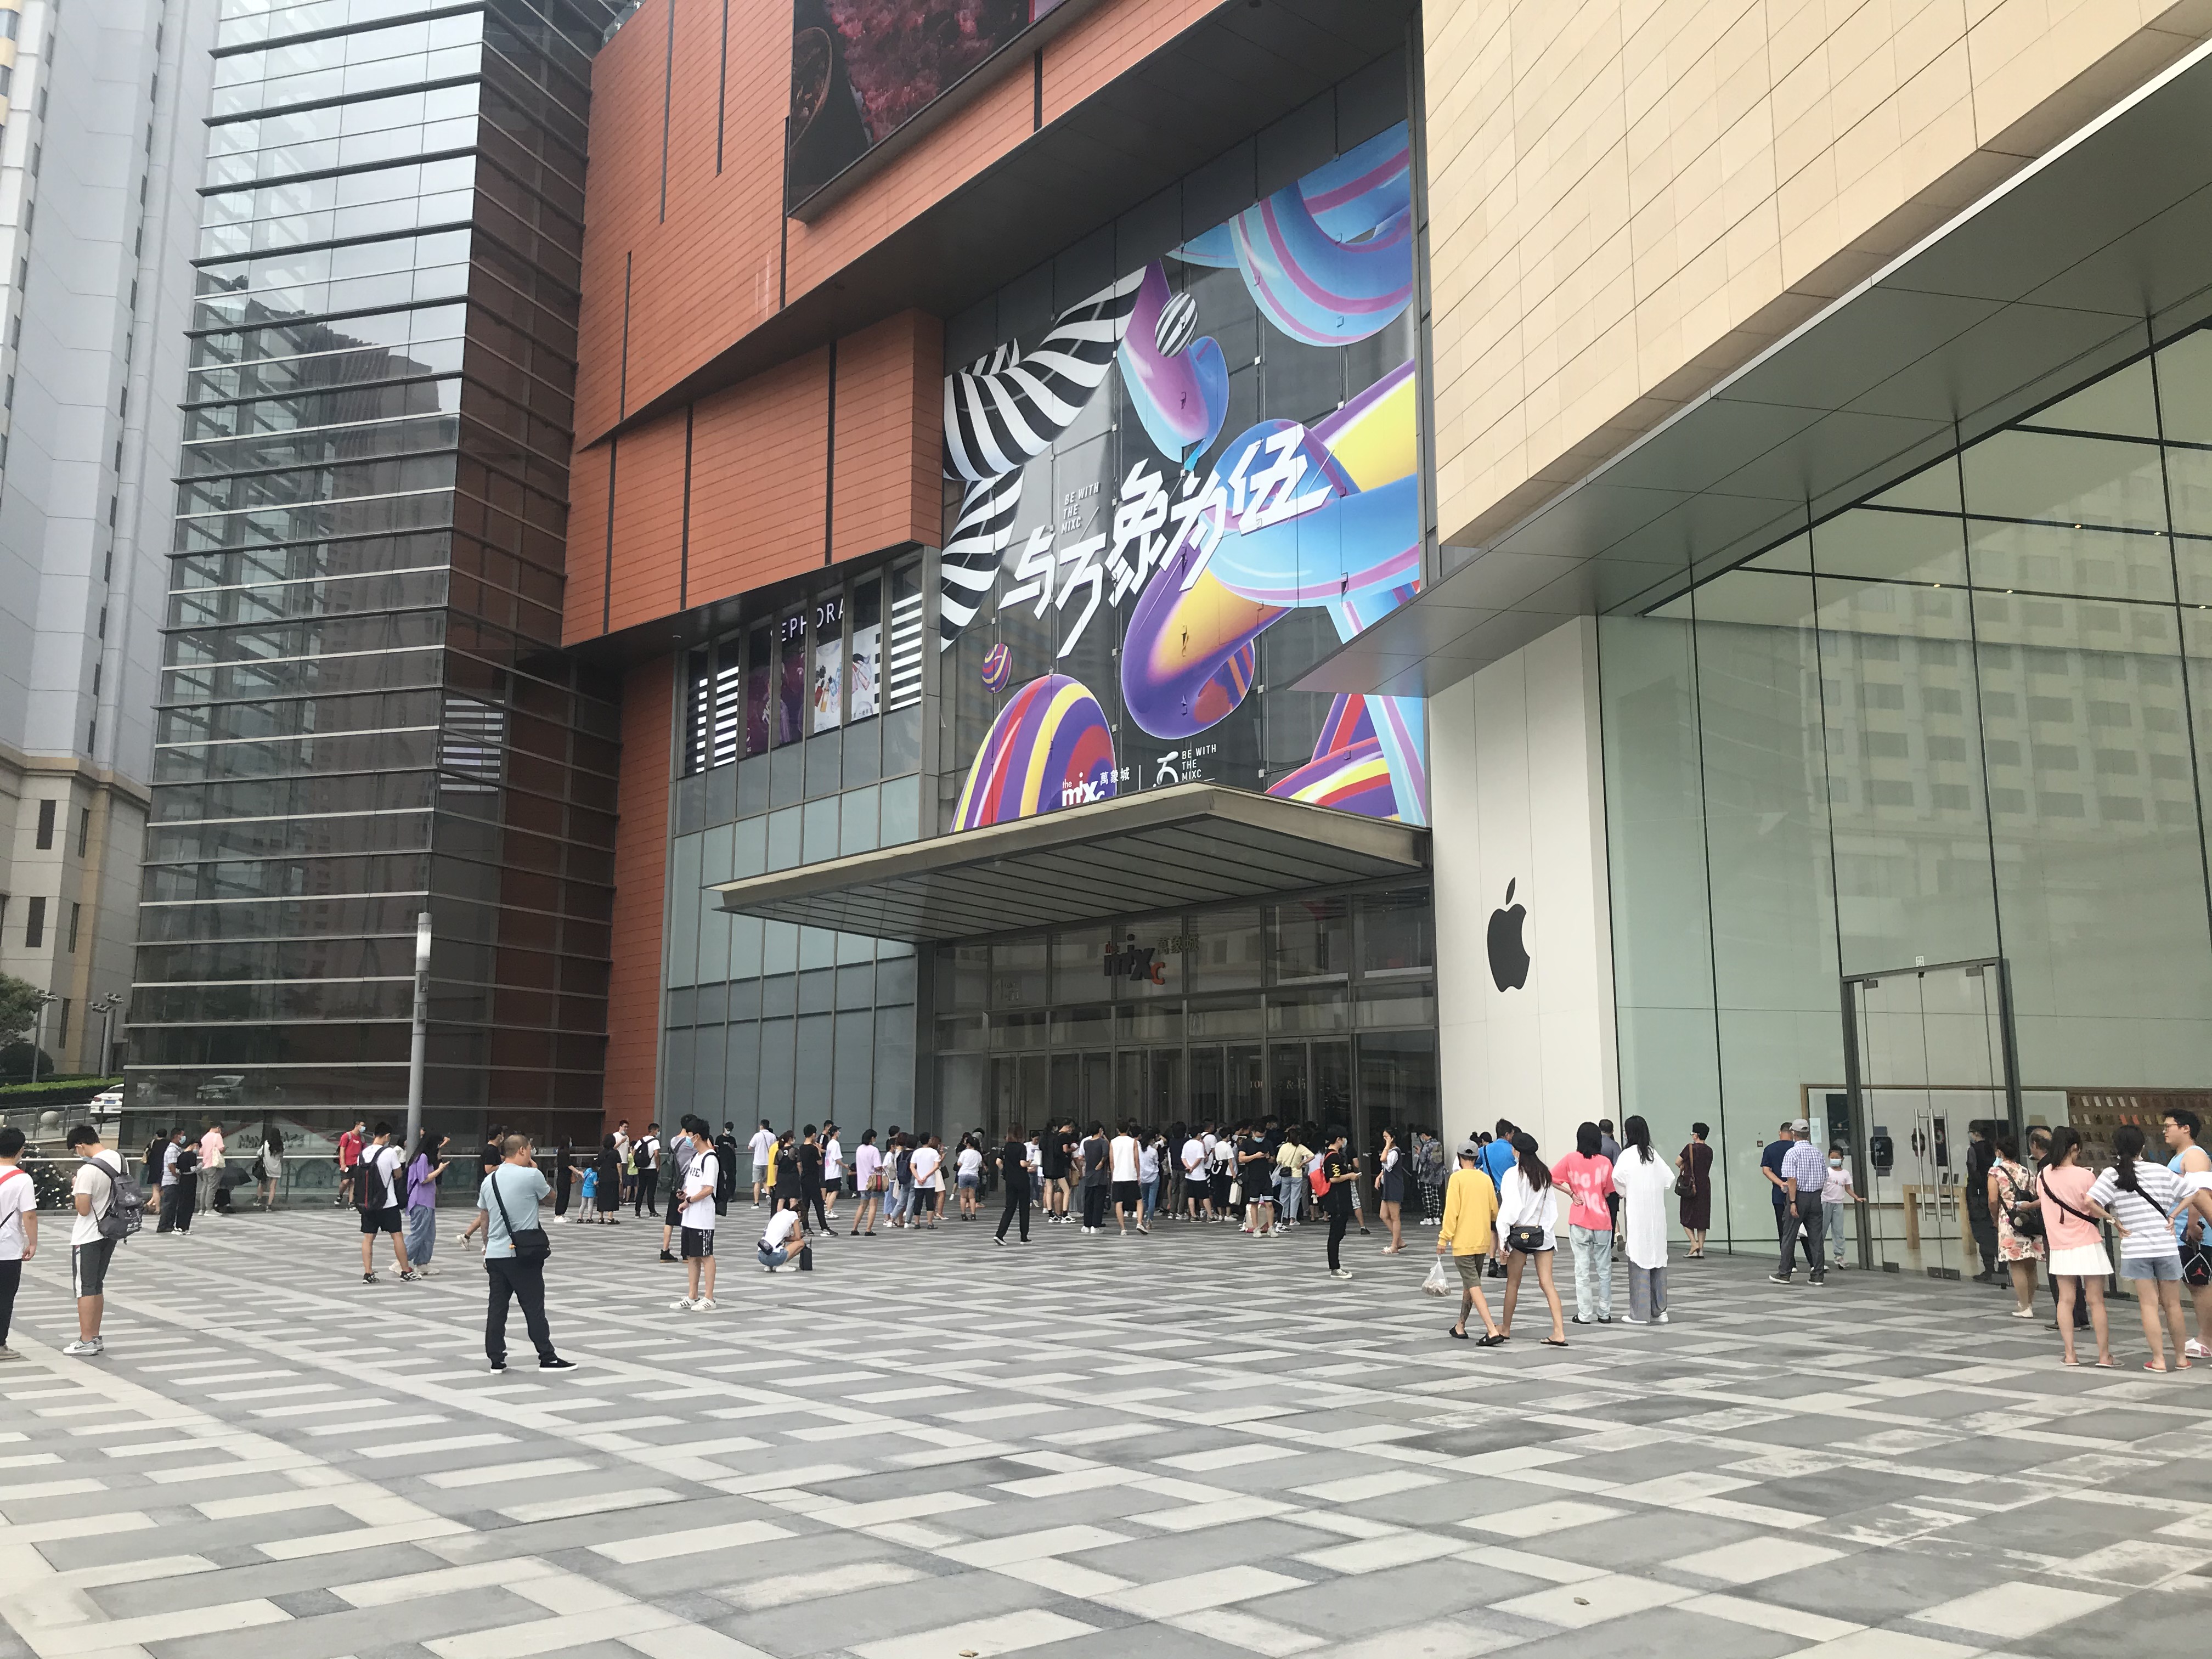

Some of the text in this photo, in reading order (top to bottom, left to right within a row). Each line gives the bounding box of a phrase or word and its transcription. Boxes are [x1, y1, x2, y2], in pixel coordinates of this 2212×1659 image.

[1065, 481, 1099, 505] BE WITH
[1063, 503, 1079, 520] THE
[1061, 516, 1081, 534] MIXC
[997, 423, 1333, 659] 与万象为伍
[770, 598, 844, 642] EPHORA
[1182, 743, 1216, 760] BE WITH
[1182, 759, 1197, 770] THE
[1062, 778, 1073, 789] the
[1100, 766, 1130, 786] 萬象城
[1182, 769, 1201, 781] MIXC
[1104, 934, 1166, 985] mixc
